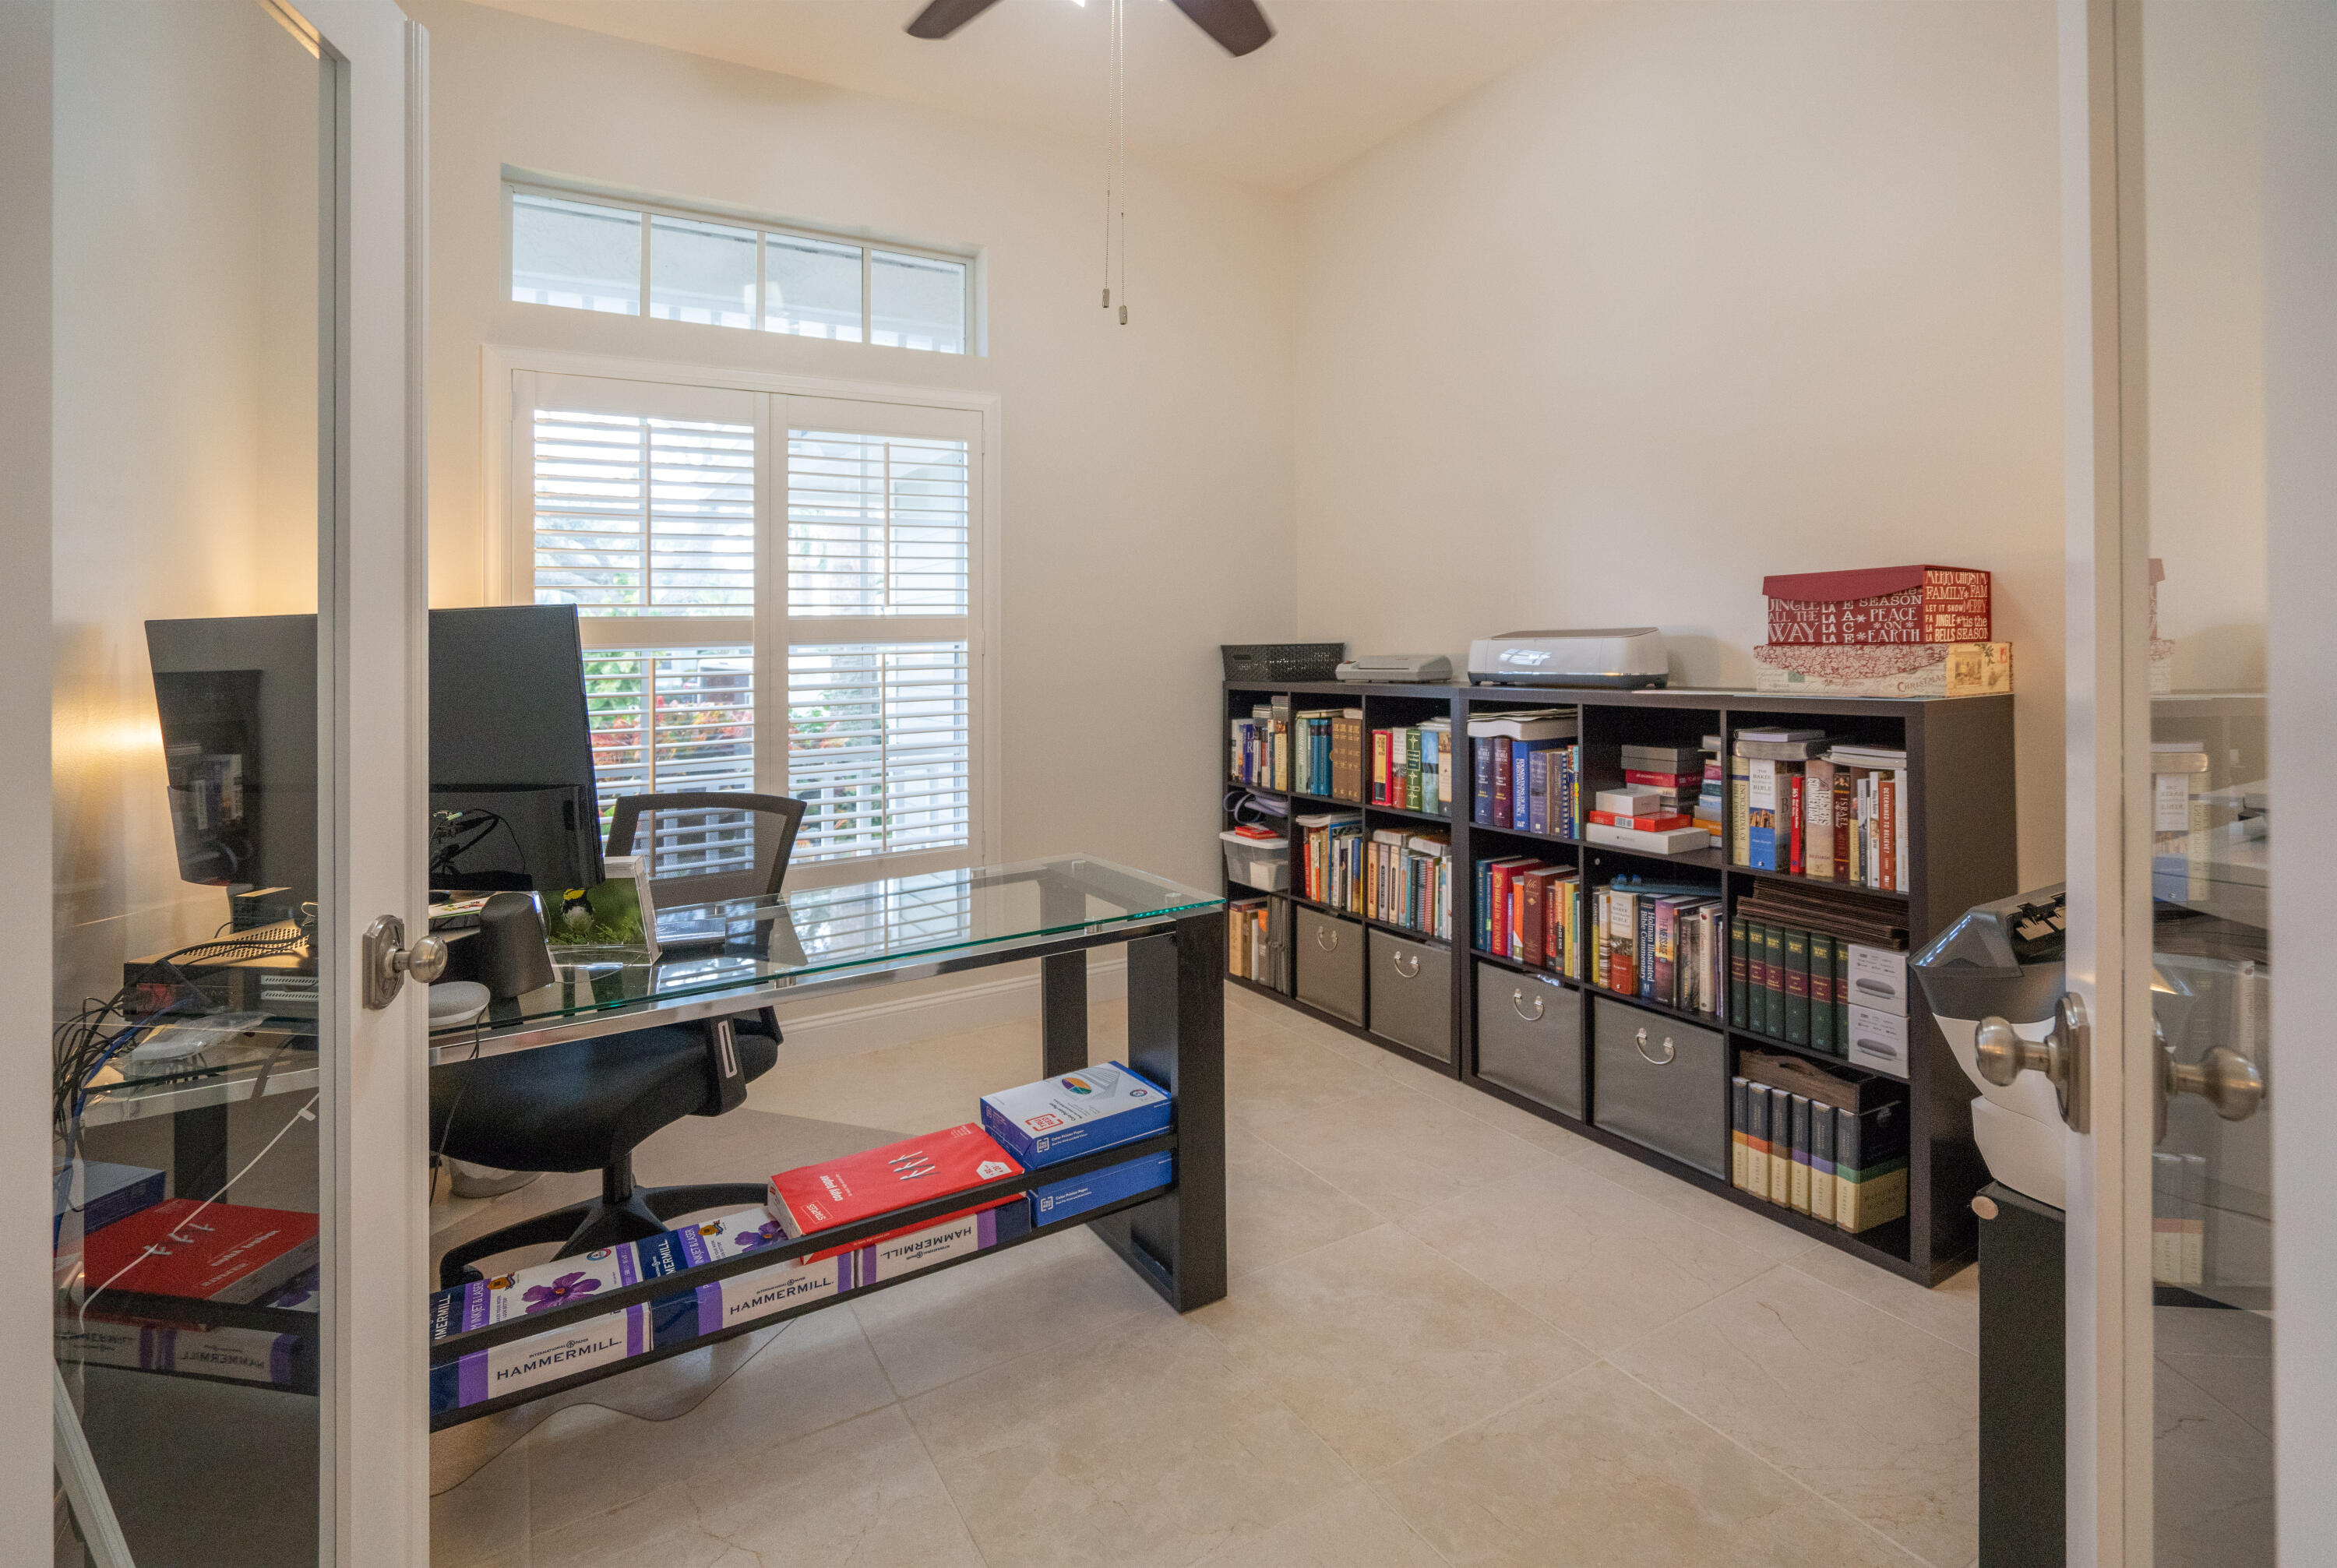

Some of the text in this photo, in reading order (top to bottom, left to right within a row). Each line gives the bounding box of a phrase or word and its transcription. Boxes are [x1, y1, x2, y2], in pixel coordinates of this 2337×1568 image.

[1926, 570, 1954, 585] MERRY
[1926, 587, 1966, 599] FAMILY
[1859, 595, 1923, 607] SEASON
[1822, 604, 1836, 613] LA
[1870, 608, 1917, 622] PEACE
[1768, 611, 1817, 622] ALL THE
[1822, 615, 1836, 623] LA
[1935, 614, 1955, 626] JINGLE
[1975, 615, 1987, 626] the
[1768, 622, 1820, 642] WAY
[1884, 621, 1902, 630] ON
[1868, 629, 1919, 643] EARTH
[1935, 629, 1955, 642] BELLS
[1957, 628, 1988, 640] SEASON
[1807, 777, 1820, 825] COMMENTARY
[1819, 790, 1831, 826] TEACHER'S
[1740, 833, 1745, 841] OF
[1659, 928, 1668, 955] MESSAGE
[820, 1175, 843, 1201] copy paper
[806, 1203, 826, 1221] STAPLES
[685, 1228, 698, 1243] LASER
[883, 1226, 971, 1259] HAMMERMILL
[690, 1248, 704, 1264] INKJET
[473, 1281, 485, 1296] LASER
[730, 1277, 831, 1315] HAMMERMILL
[471, 1305, 485, 1323] INKJET
[529, 1344, 566, 1358] INTERNATIONAL
[497, 1338, 620, 1380] HAMMERMILL
